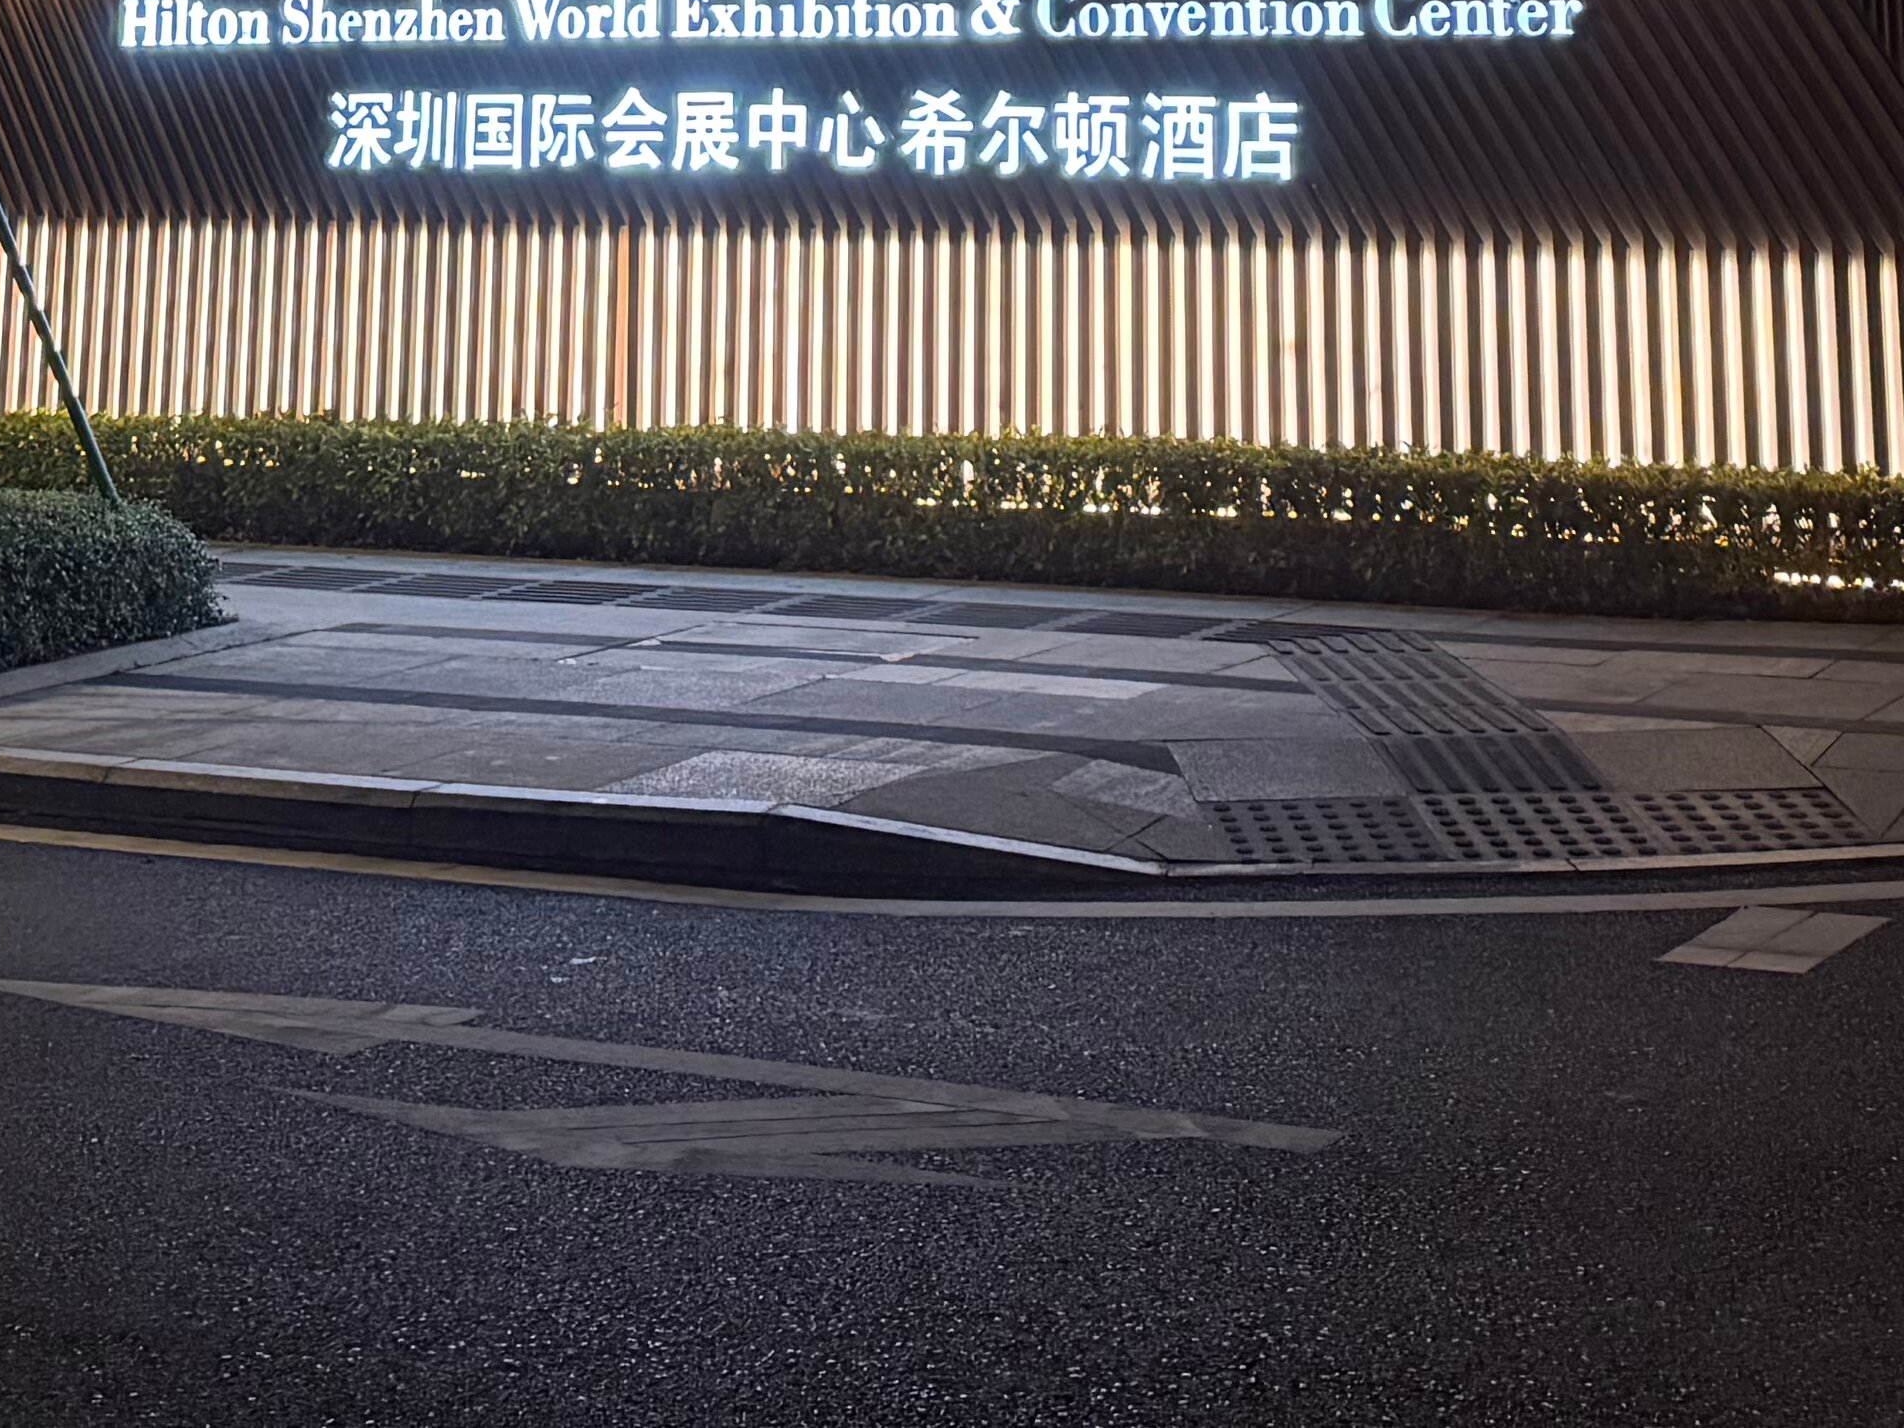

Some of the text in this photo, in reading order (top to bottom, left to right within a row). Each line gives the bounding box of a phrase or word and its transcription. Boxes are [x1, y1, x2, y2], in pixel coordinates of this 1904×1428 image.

[326, 86, 1299, 182] 深圳国际会展中心希尔顿酒店
